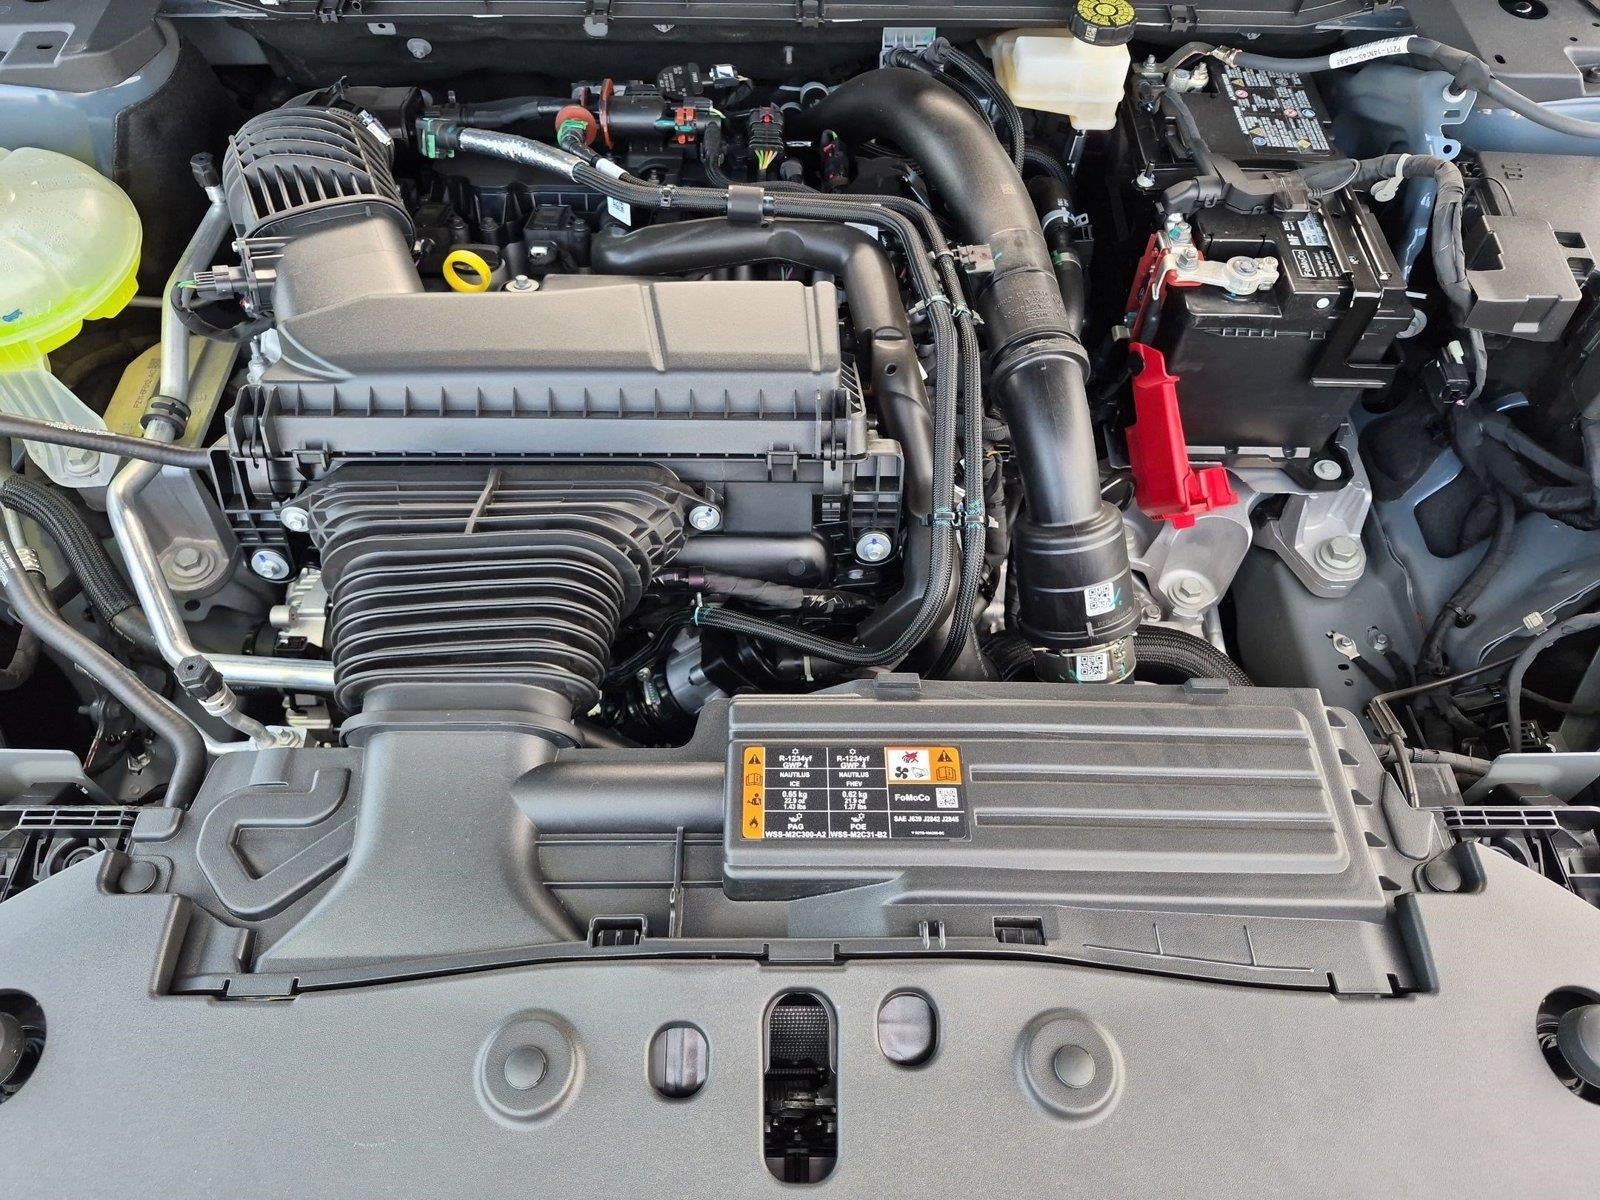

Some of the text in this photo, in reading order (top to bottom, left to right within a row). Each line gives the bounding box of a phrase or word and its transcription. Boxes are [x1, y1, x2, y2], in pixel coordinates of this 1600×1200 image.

[779, 755, 812, 763] R-1234yf
[837, 755, 870, 763] R-1234yf
[798, 791, 808, 799] kg
[858, 791, 868, 799] kg
[894, 794, 931, 802] FoMoCo
